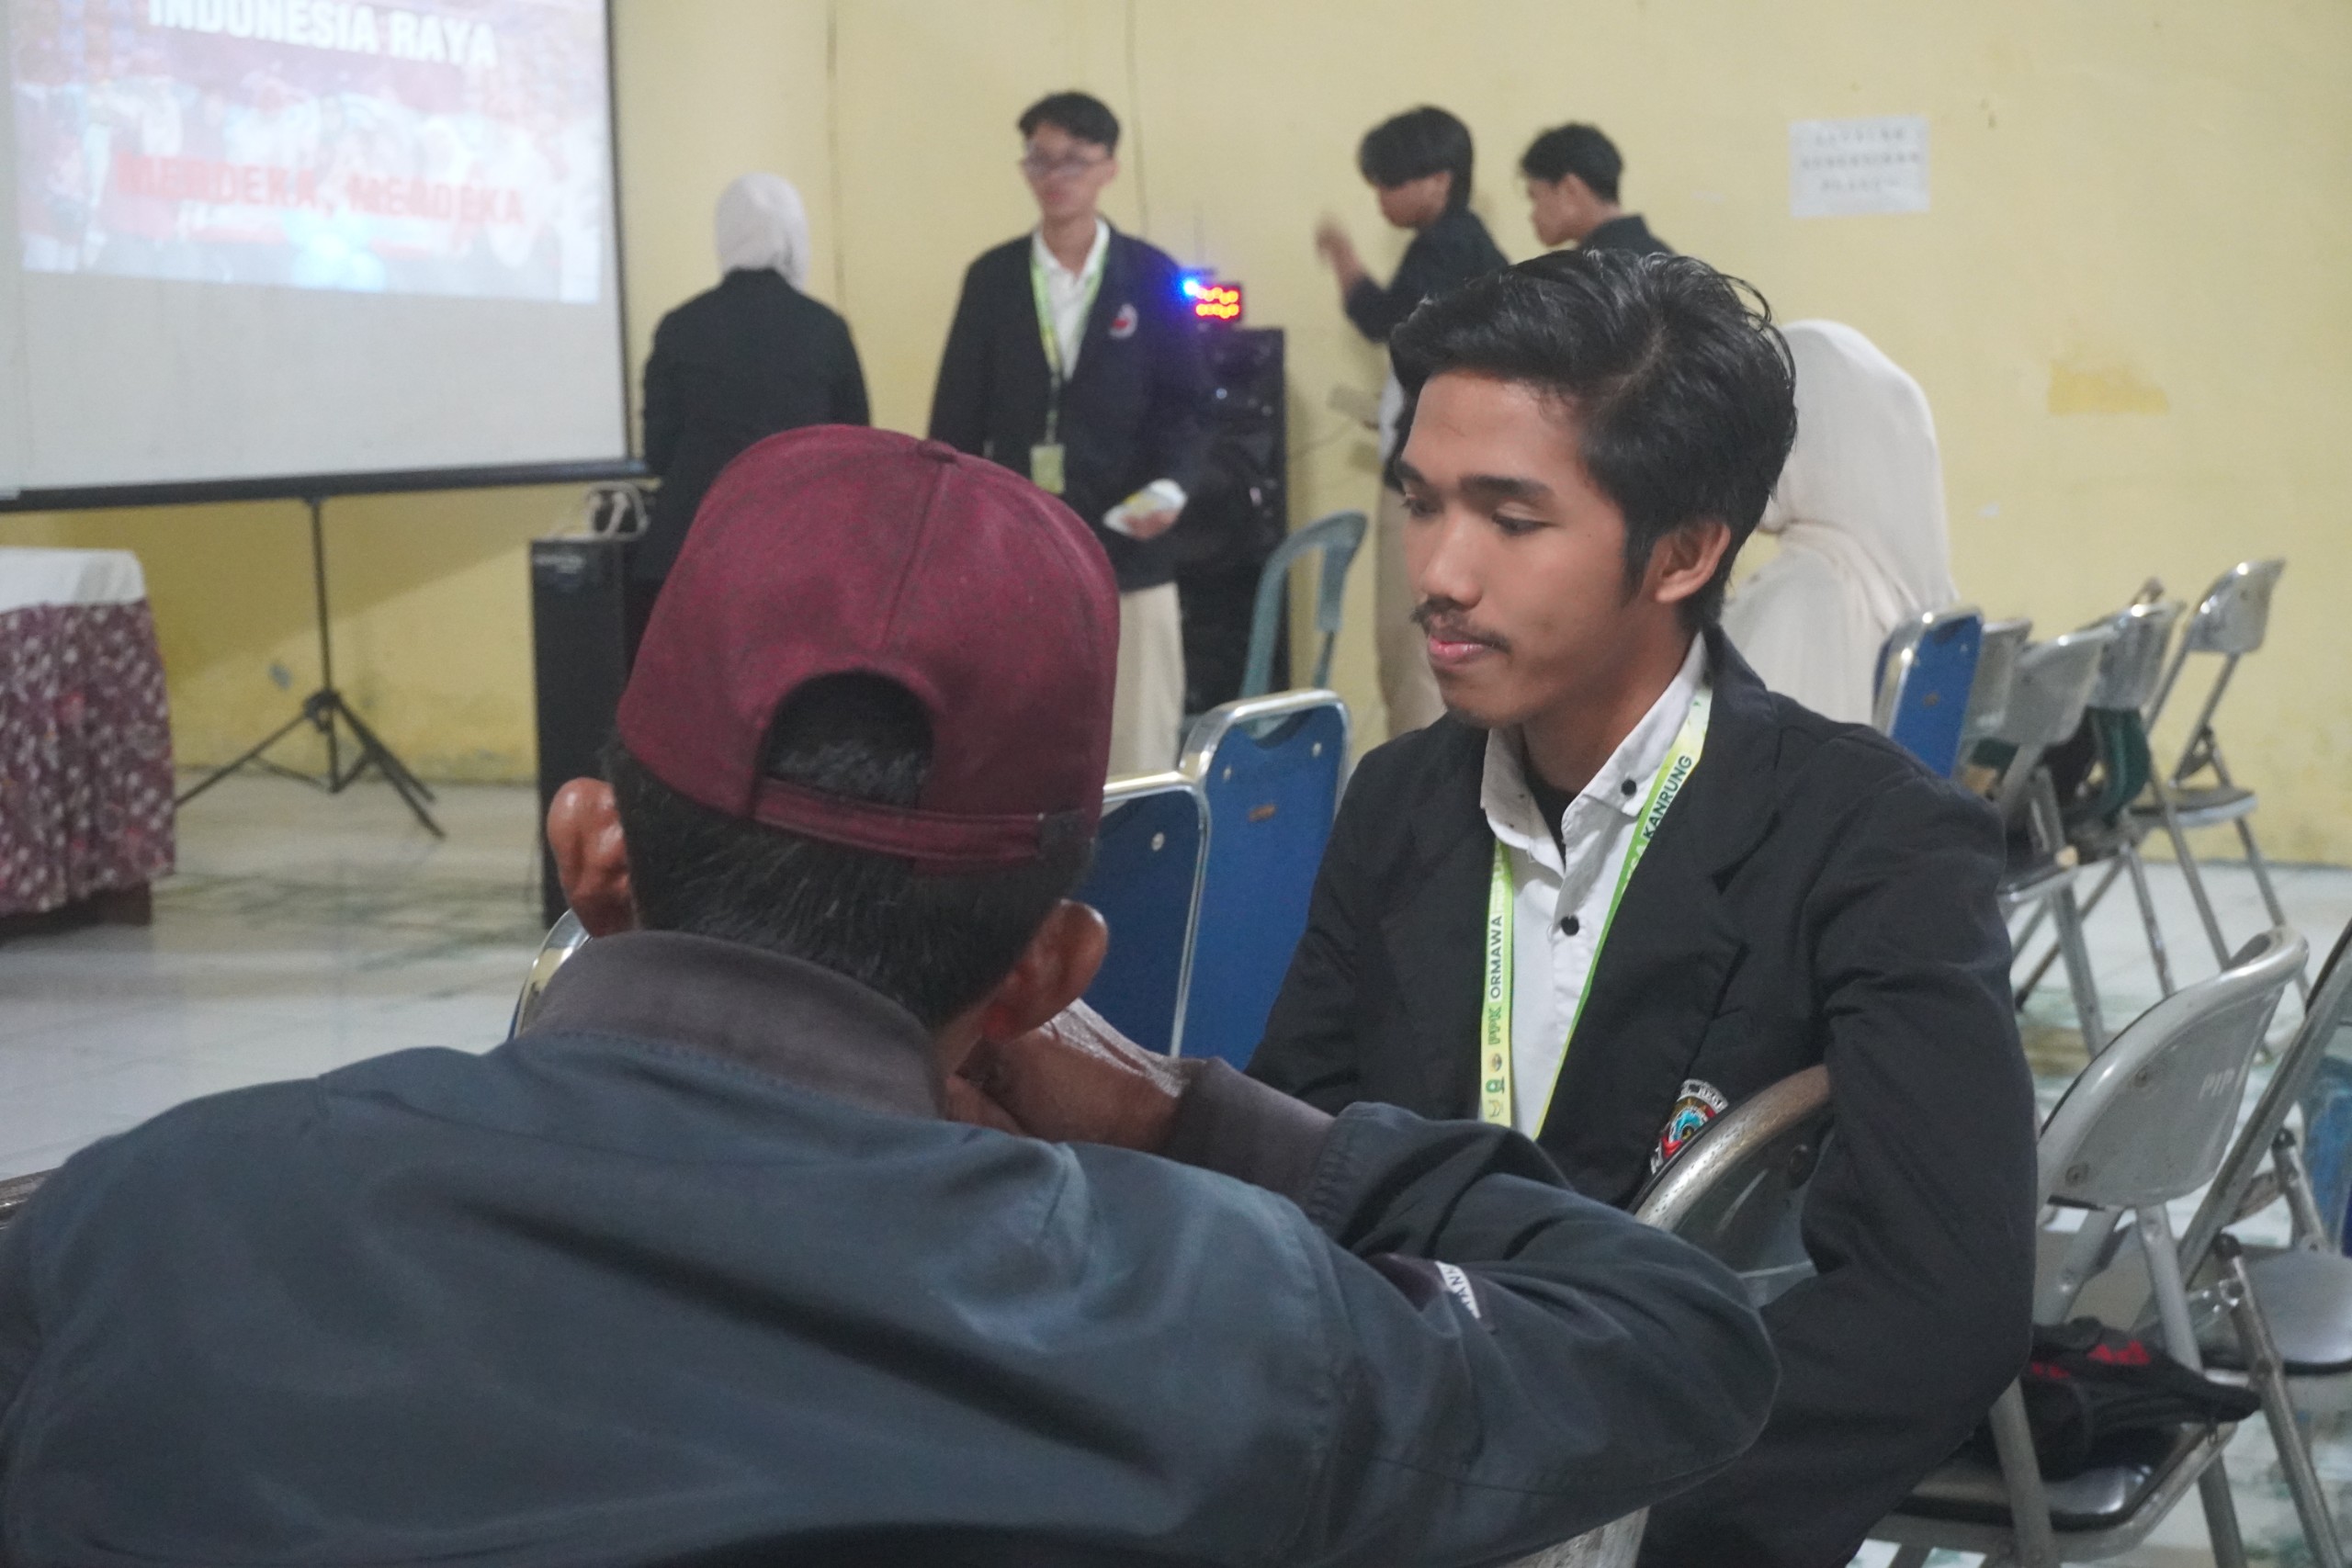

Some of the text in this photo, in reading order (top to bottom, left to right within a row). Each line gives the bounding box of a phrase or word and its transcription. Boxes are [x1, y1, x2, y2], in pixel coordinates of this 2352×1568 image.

[148, 0, 498, 68] INDONESIA RAYA
[1643, 755, 1692, 840] KANRUNG
[1490, 915, 1503, 999] ORMAWA
[1487, 1007, 1501, 1045] PPK
